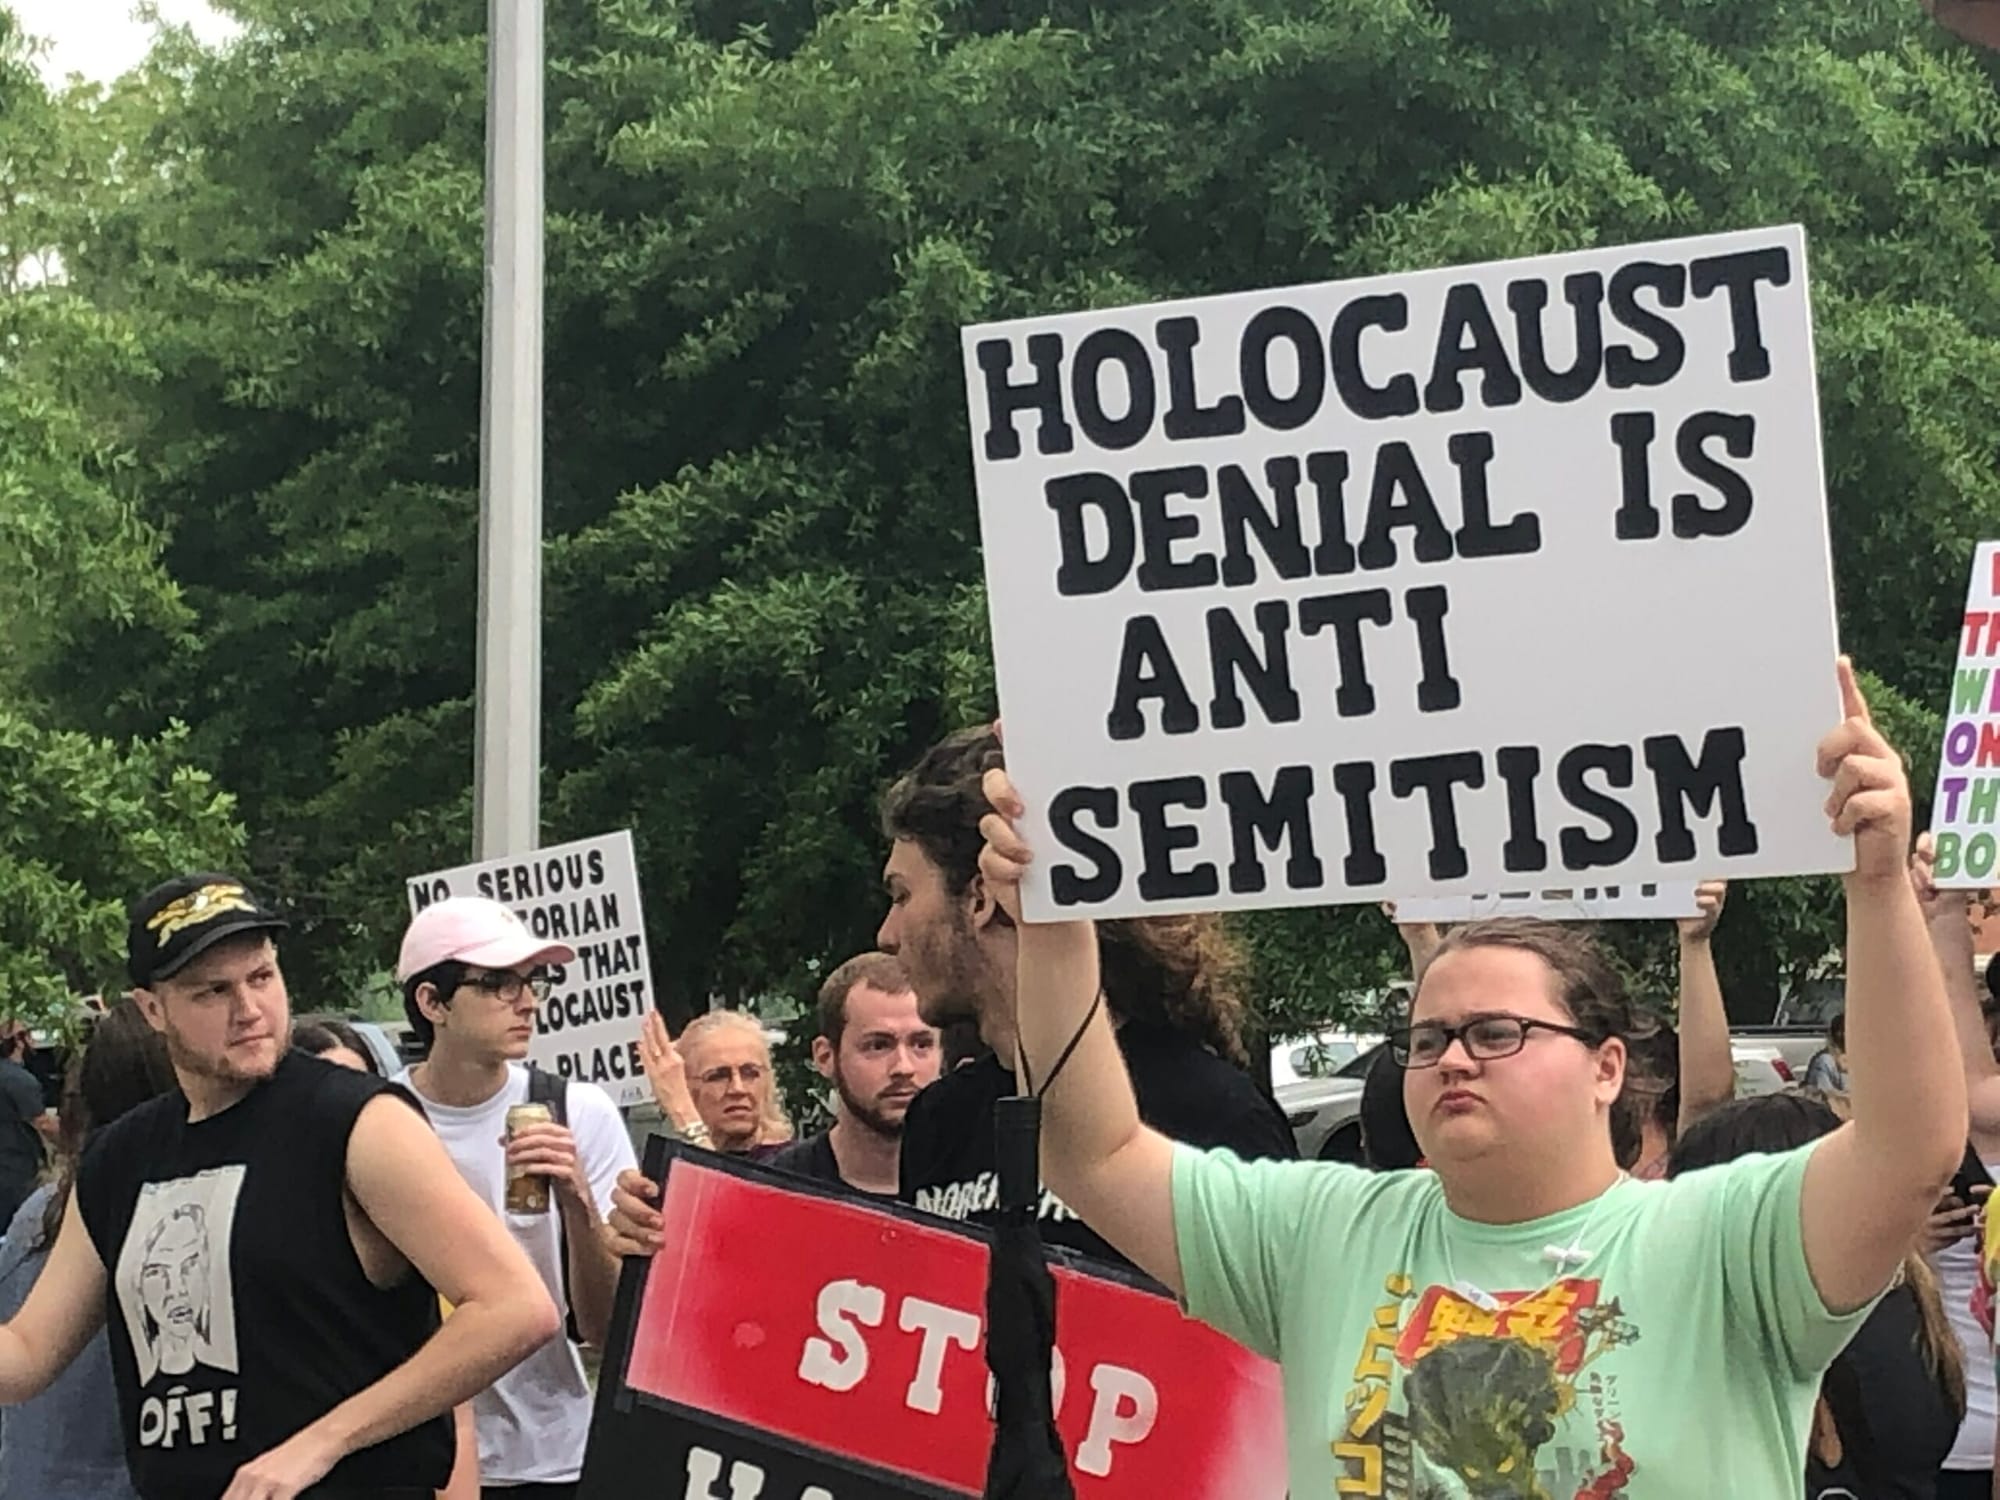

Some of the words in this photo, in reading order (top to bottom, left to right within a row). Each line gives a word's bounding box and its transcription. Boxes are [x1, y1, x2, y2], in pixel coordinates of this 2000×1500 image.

[976, 246, 1791, 461] HOLOCAUST
[1044, 431, 1541, 596] DENIAL
[1610, 411, 1756, 540] IS
[1107, 585, 1461, 741] ANTI
[1048, 726, 1759, 907] SEMITISM
[413, 878, 450, 913] NO
[477, 849, 604, 902] SERIOUS
[1934, 832, 2000, 879] BO
[577, 934, 641, 981] THAT
[534, 979, 645, 1035] LOCAUST
[557, 1041, 645, 1083] PLACE
[799, 1278, 1159, 1477] STP
[140, 1386, 238, 1448] OFF!
